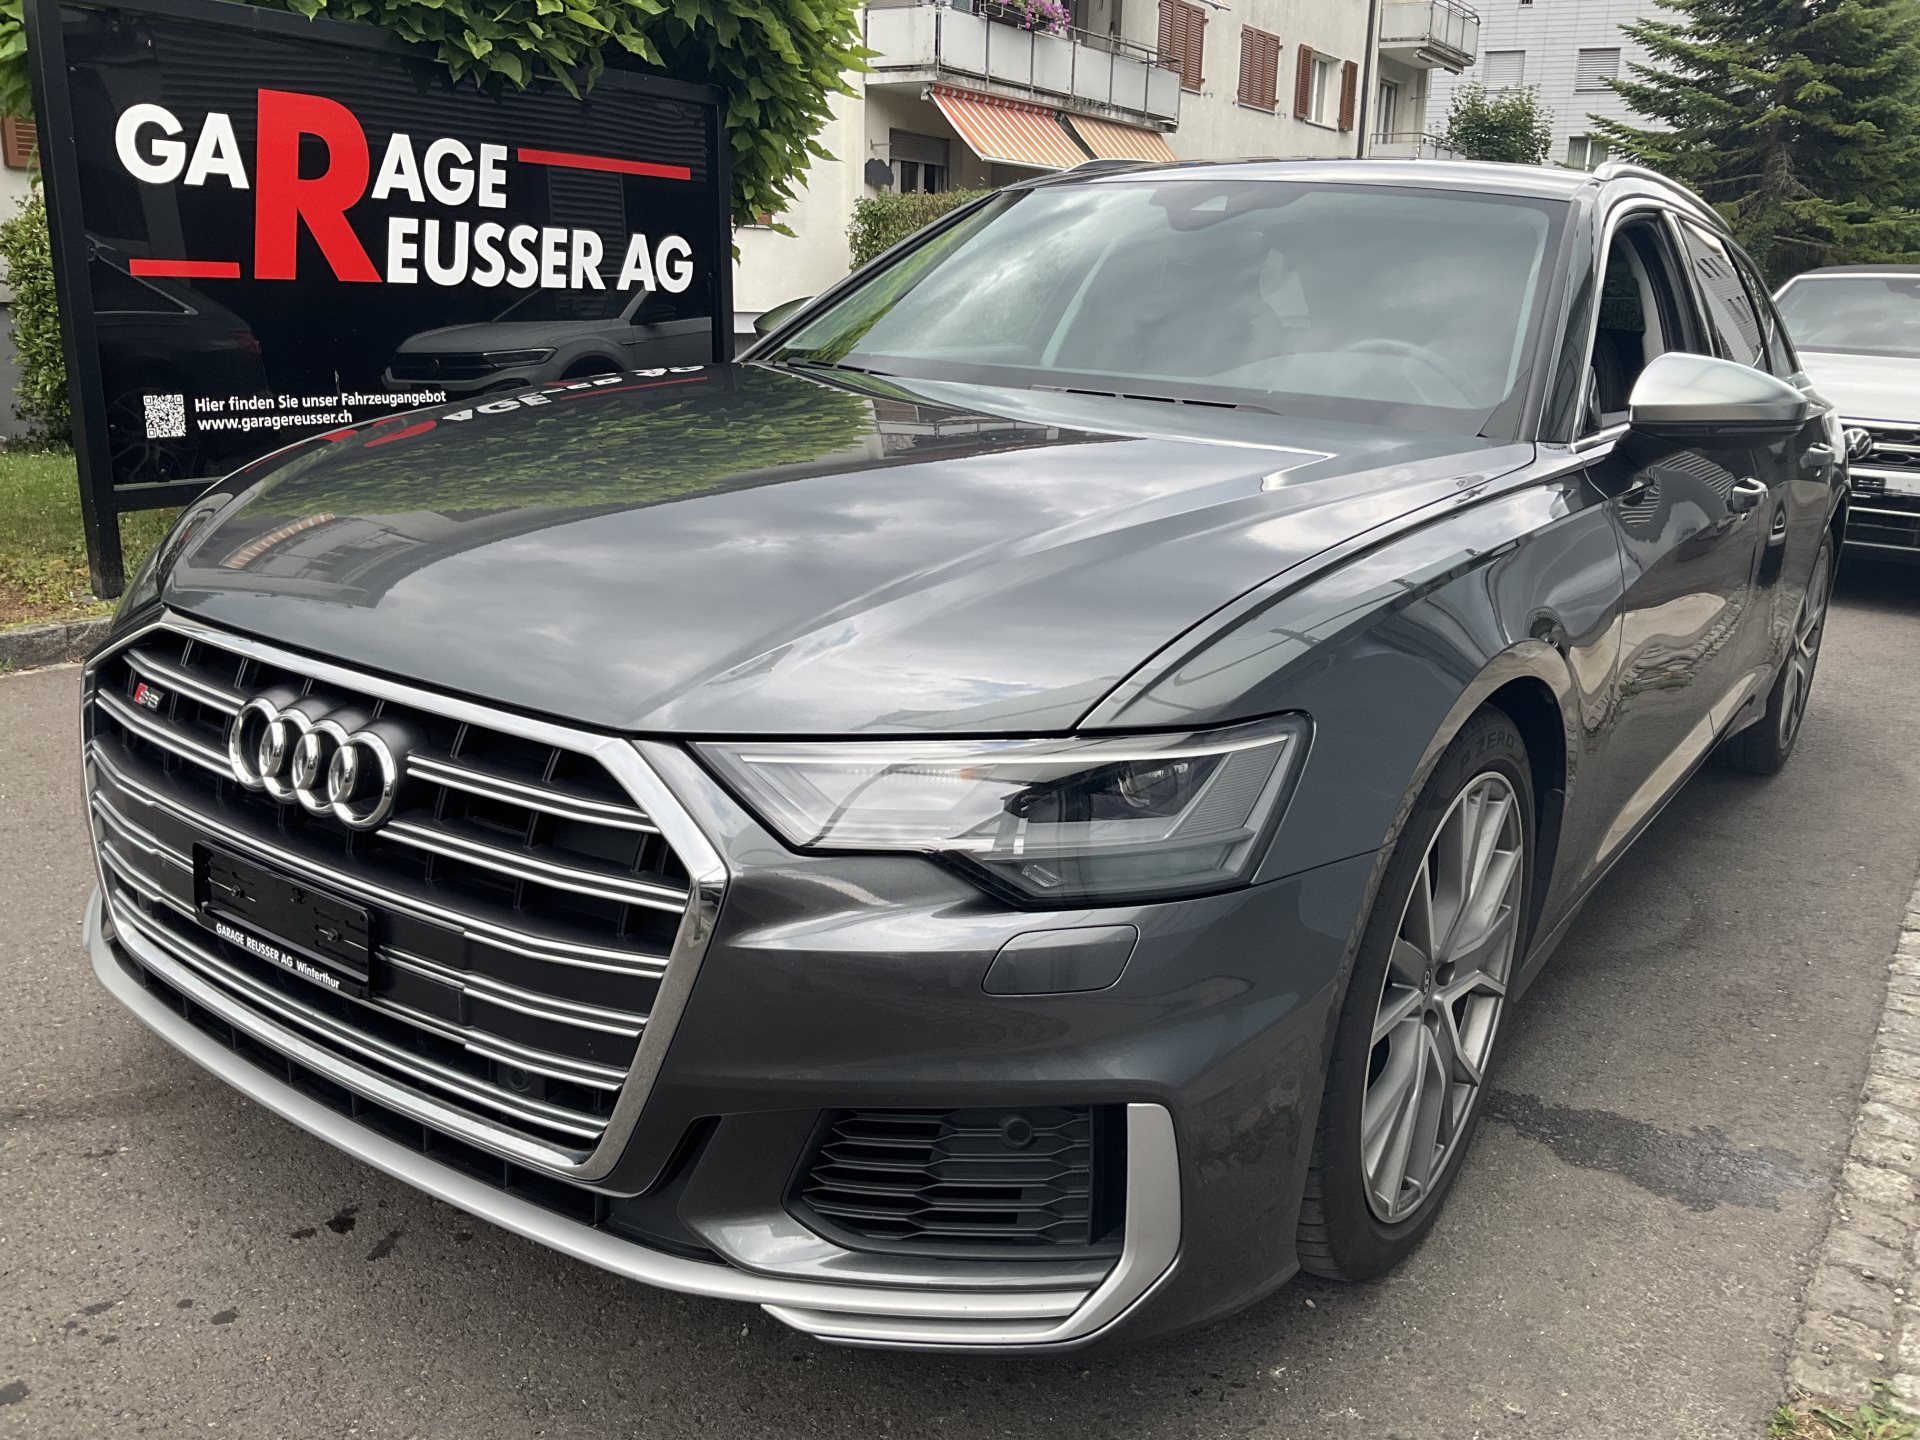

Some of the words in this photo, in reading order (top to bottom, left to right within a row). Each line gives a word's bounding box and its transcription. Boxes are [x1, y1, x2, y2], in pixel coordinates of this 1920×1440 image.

[616, 233, 694, 293] AG
[195, 398, 225, 412] Hier
[228, 395, 275, 411] finden
[278, 394, 299, 409] Sie
[302, 394, 339, 408] unser
[341, 389, 447, 408] Fahrzeugangebot
[197, 410, 353, 432] www.garagereusser.ch
[216, 923, 244, 945] GARAGE
[246, 936, 280, 961] REUSSER
[280, 953, 293, 967] AG
[296, 960, 340, 989] Winterthur
